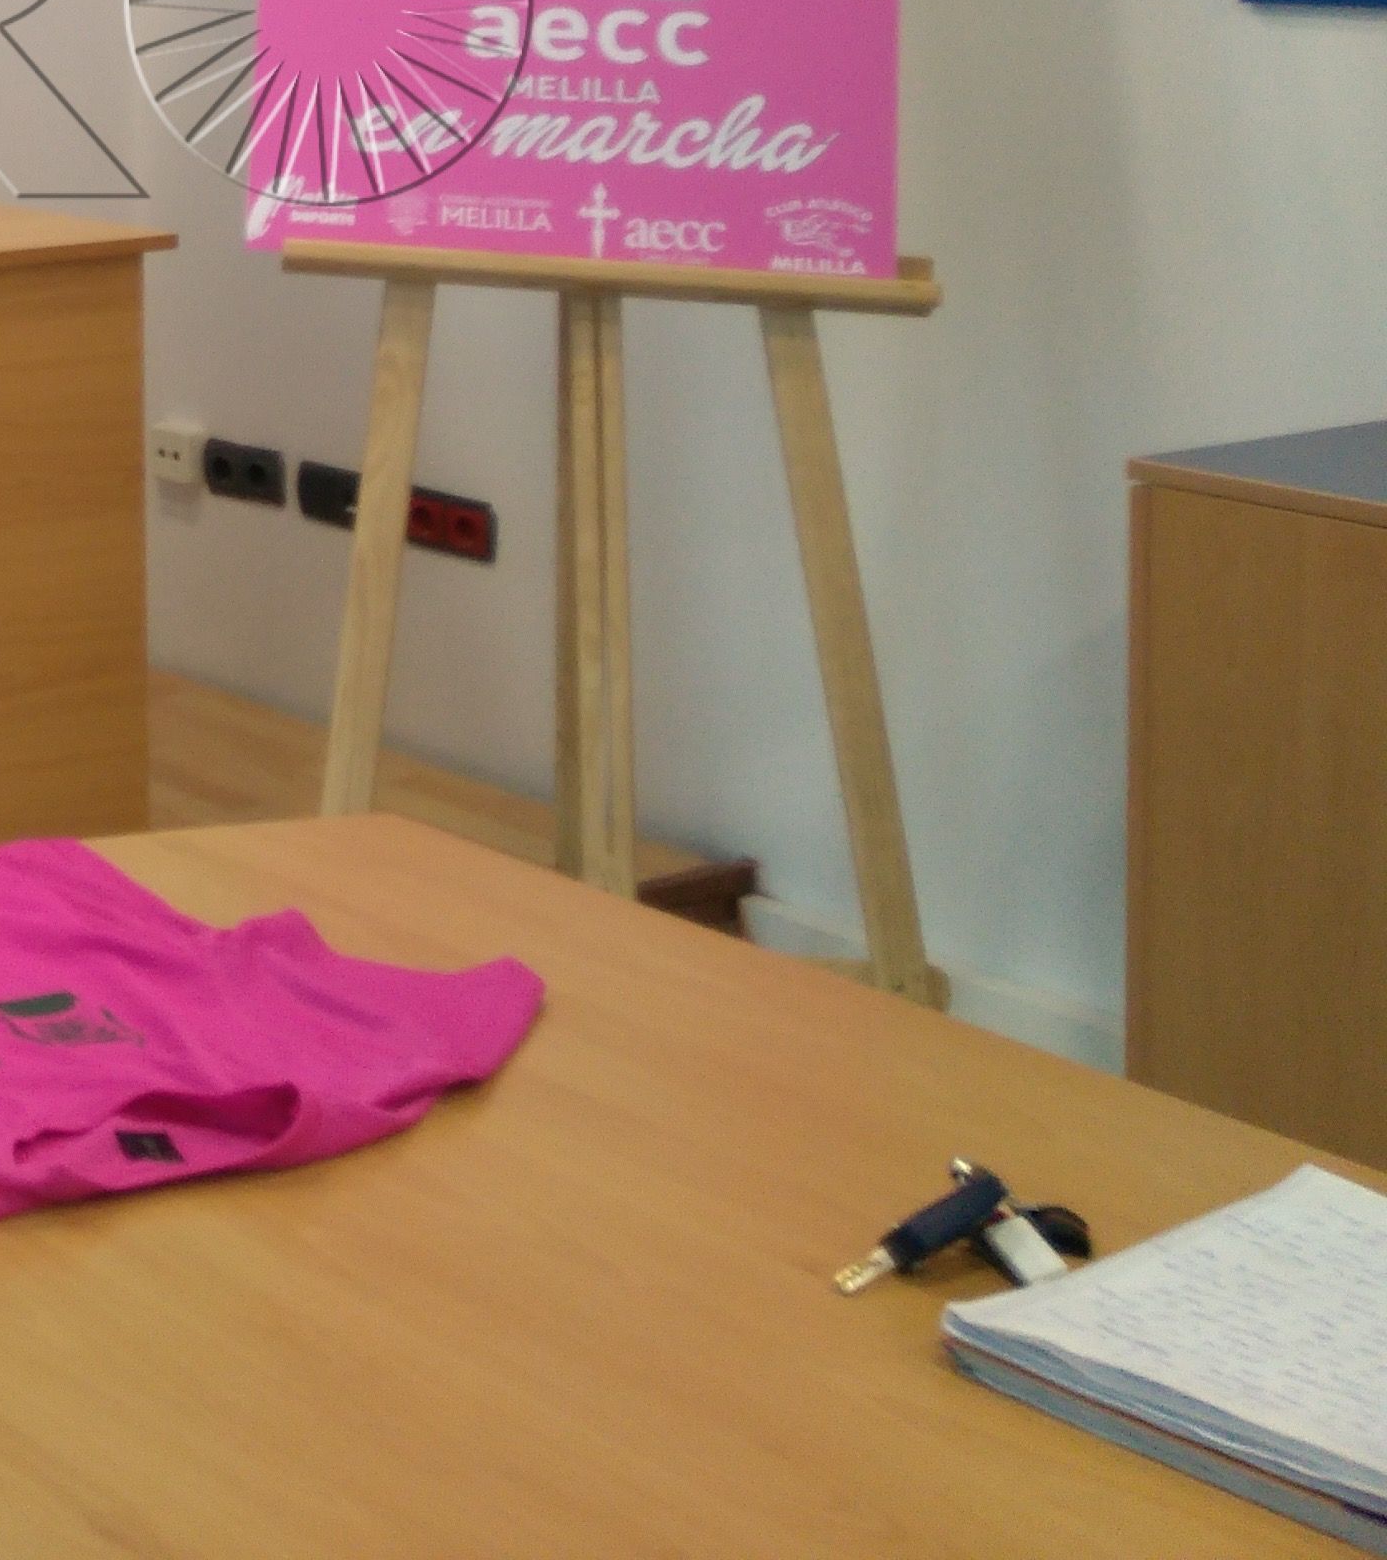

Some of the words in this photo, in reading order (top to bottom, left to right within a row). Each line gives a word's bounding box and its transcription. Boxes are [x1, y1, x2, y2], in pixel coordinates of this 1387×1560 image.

[465, 5, 711, 68] aecc
[506, 73, 662, 105] MELILLA
[481, 93, 839, 173] marcha
[439, 205, 553, 232] MELILLA
[624, 217, 727, 253] aecc
